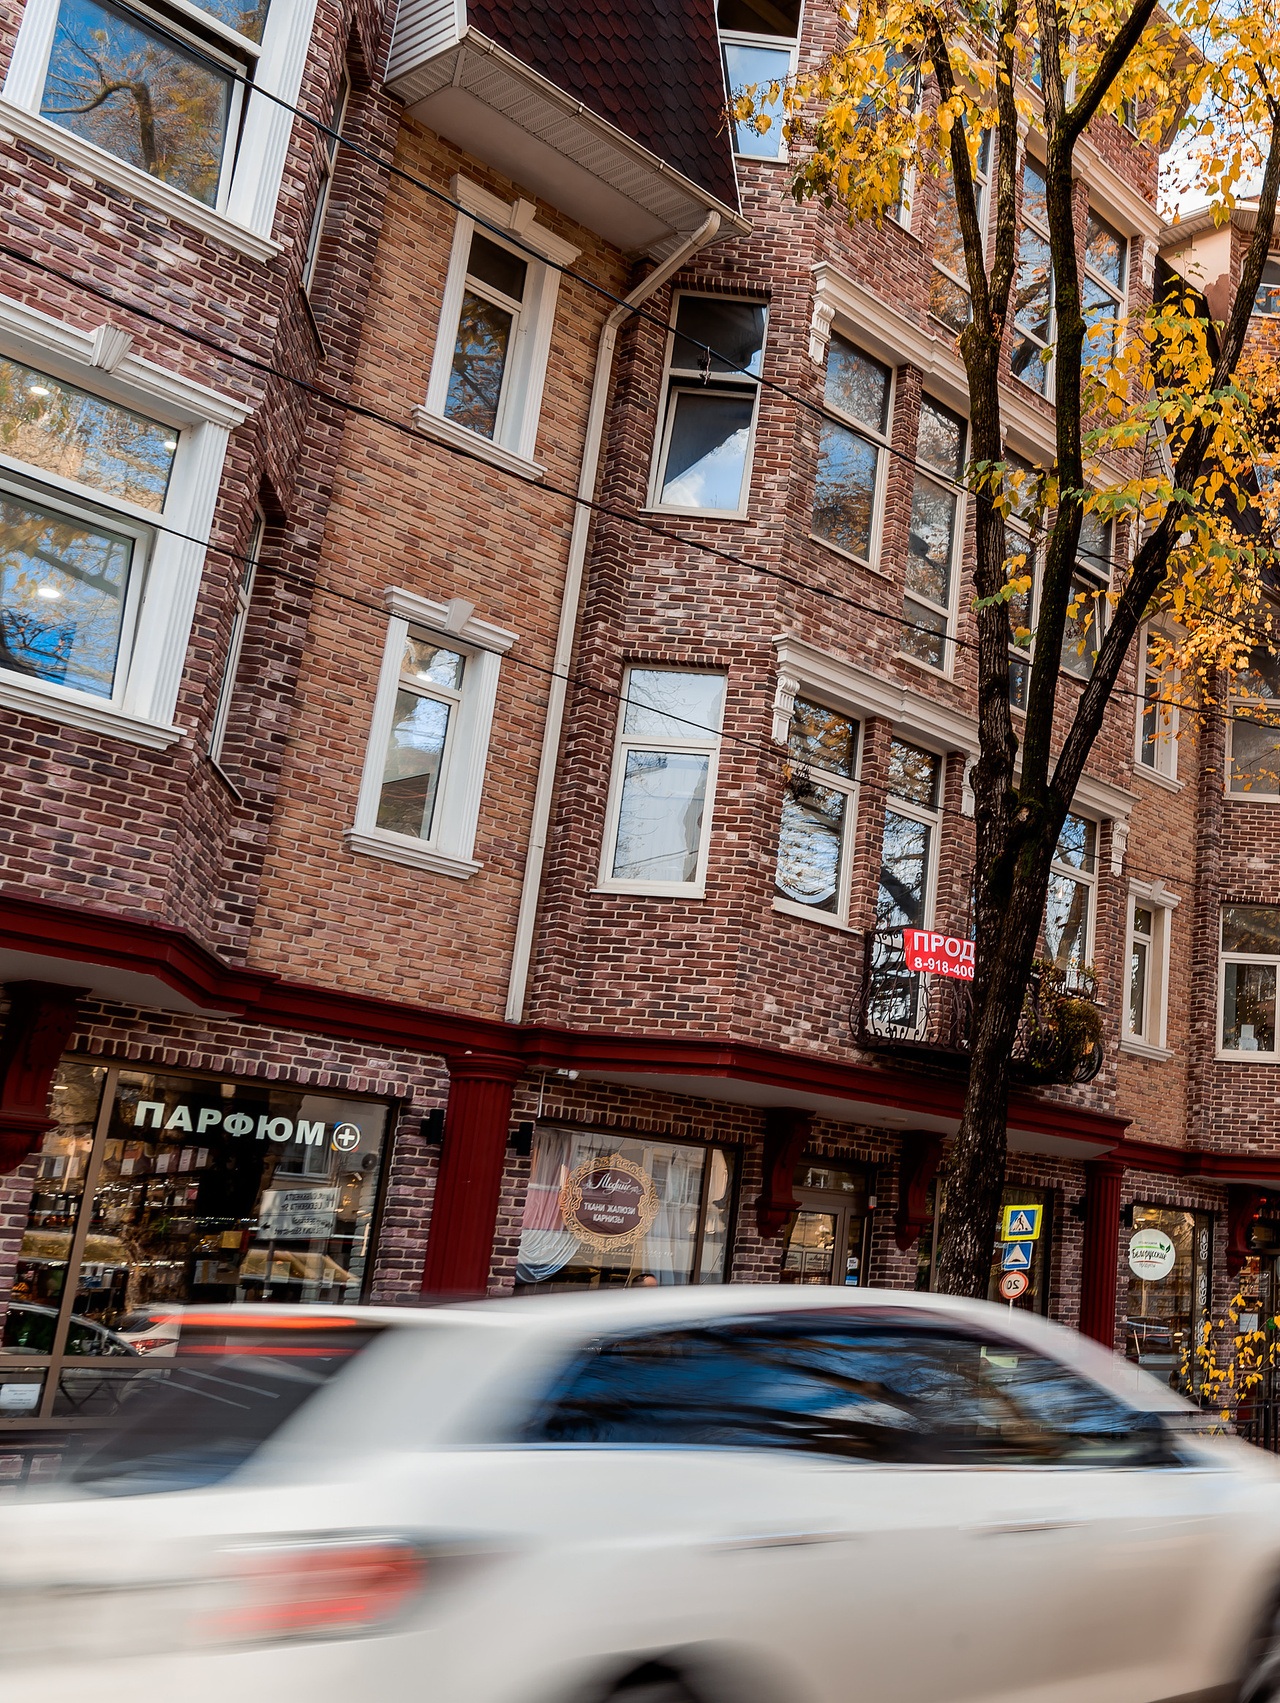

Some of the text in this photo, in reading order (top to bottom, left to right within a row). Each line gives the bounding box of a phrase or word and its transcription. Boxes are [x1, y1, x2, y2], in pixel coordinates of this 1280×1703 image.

[914, 932, 975, 965] ПРОД
[914, 957, 975, 978] 8-918-400
[134, 1100, 326, 1147] ПАРФЮМ
[584, 1202, 636, 1215] ТКАНИ ЖАЛЮЗИ
[593, 1213, 624, 1224] КАРНИЗЫ
